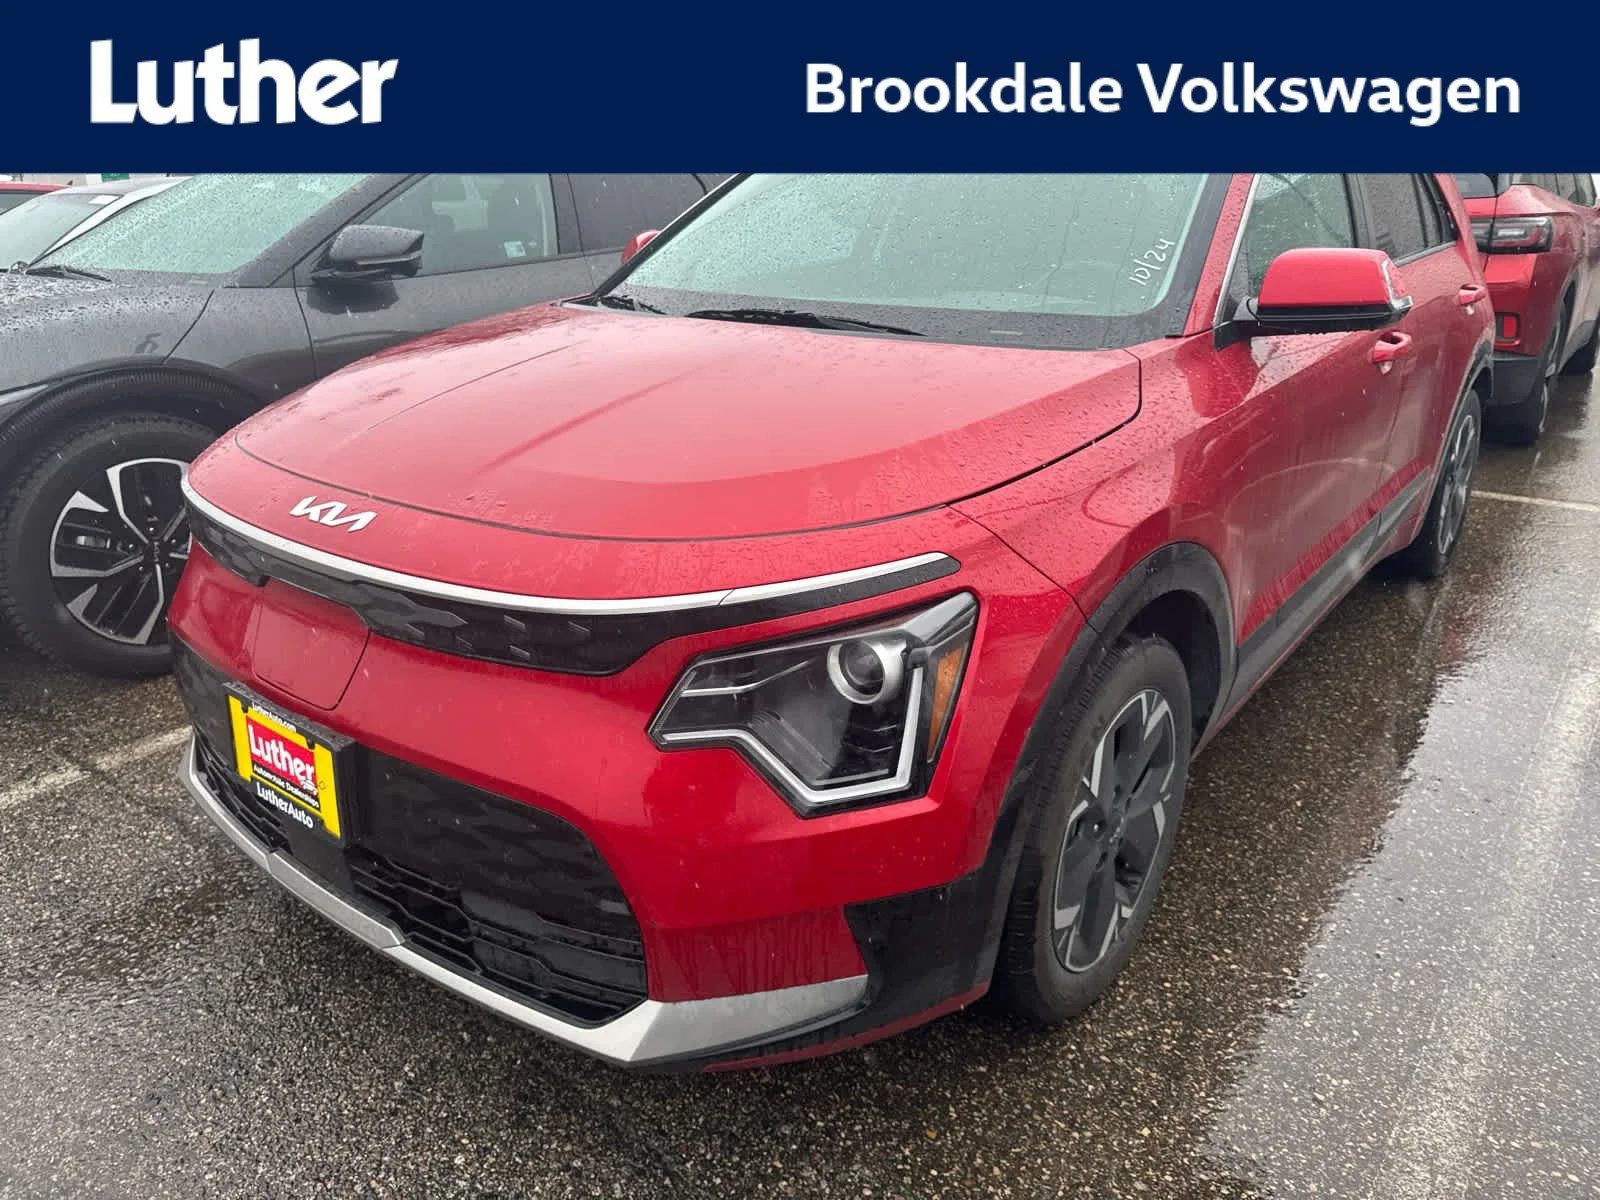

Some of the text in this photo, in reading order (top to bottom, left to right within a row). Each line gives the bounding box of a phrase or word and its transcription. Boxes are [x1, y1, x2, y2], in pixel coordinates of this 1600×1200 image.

[1129, 238, 1176, 286] 10/24
[248, 723, 315, 782] Luther
[256, 782, 314, 829] LutherAuto
